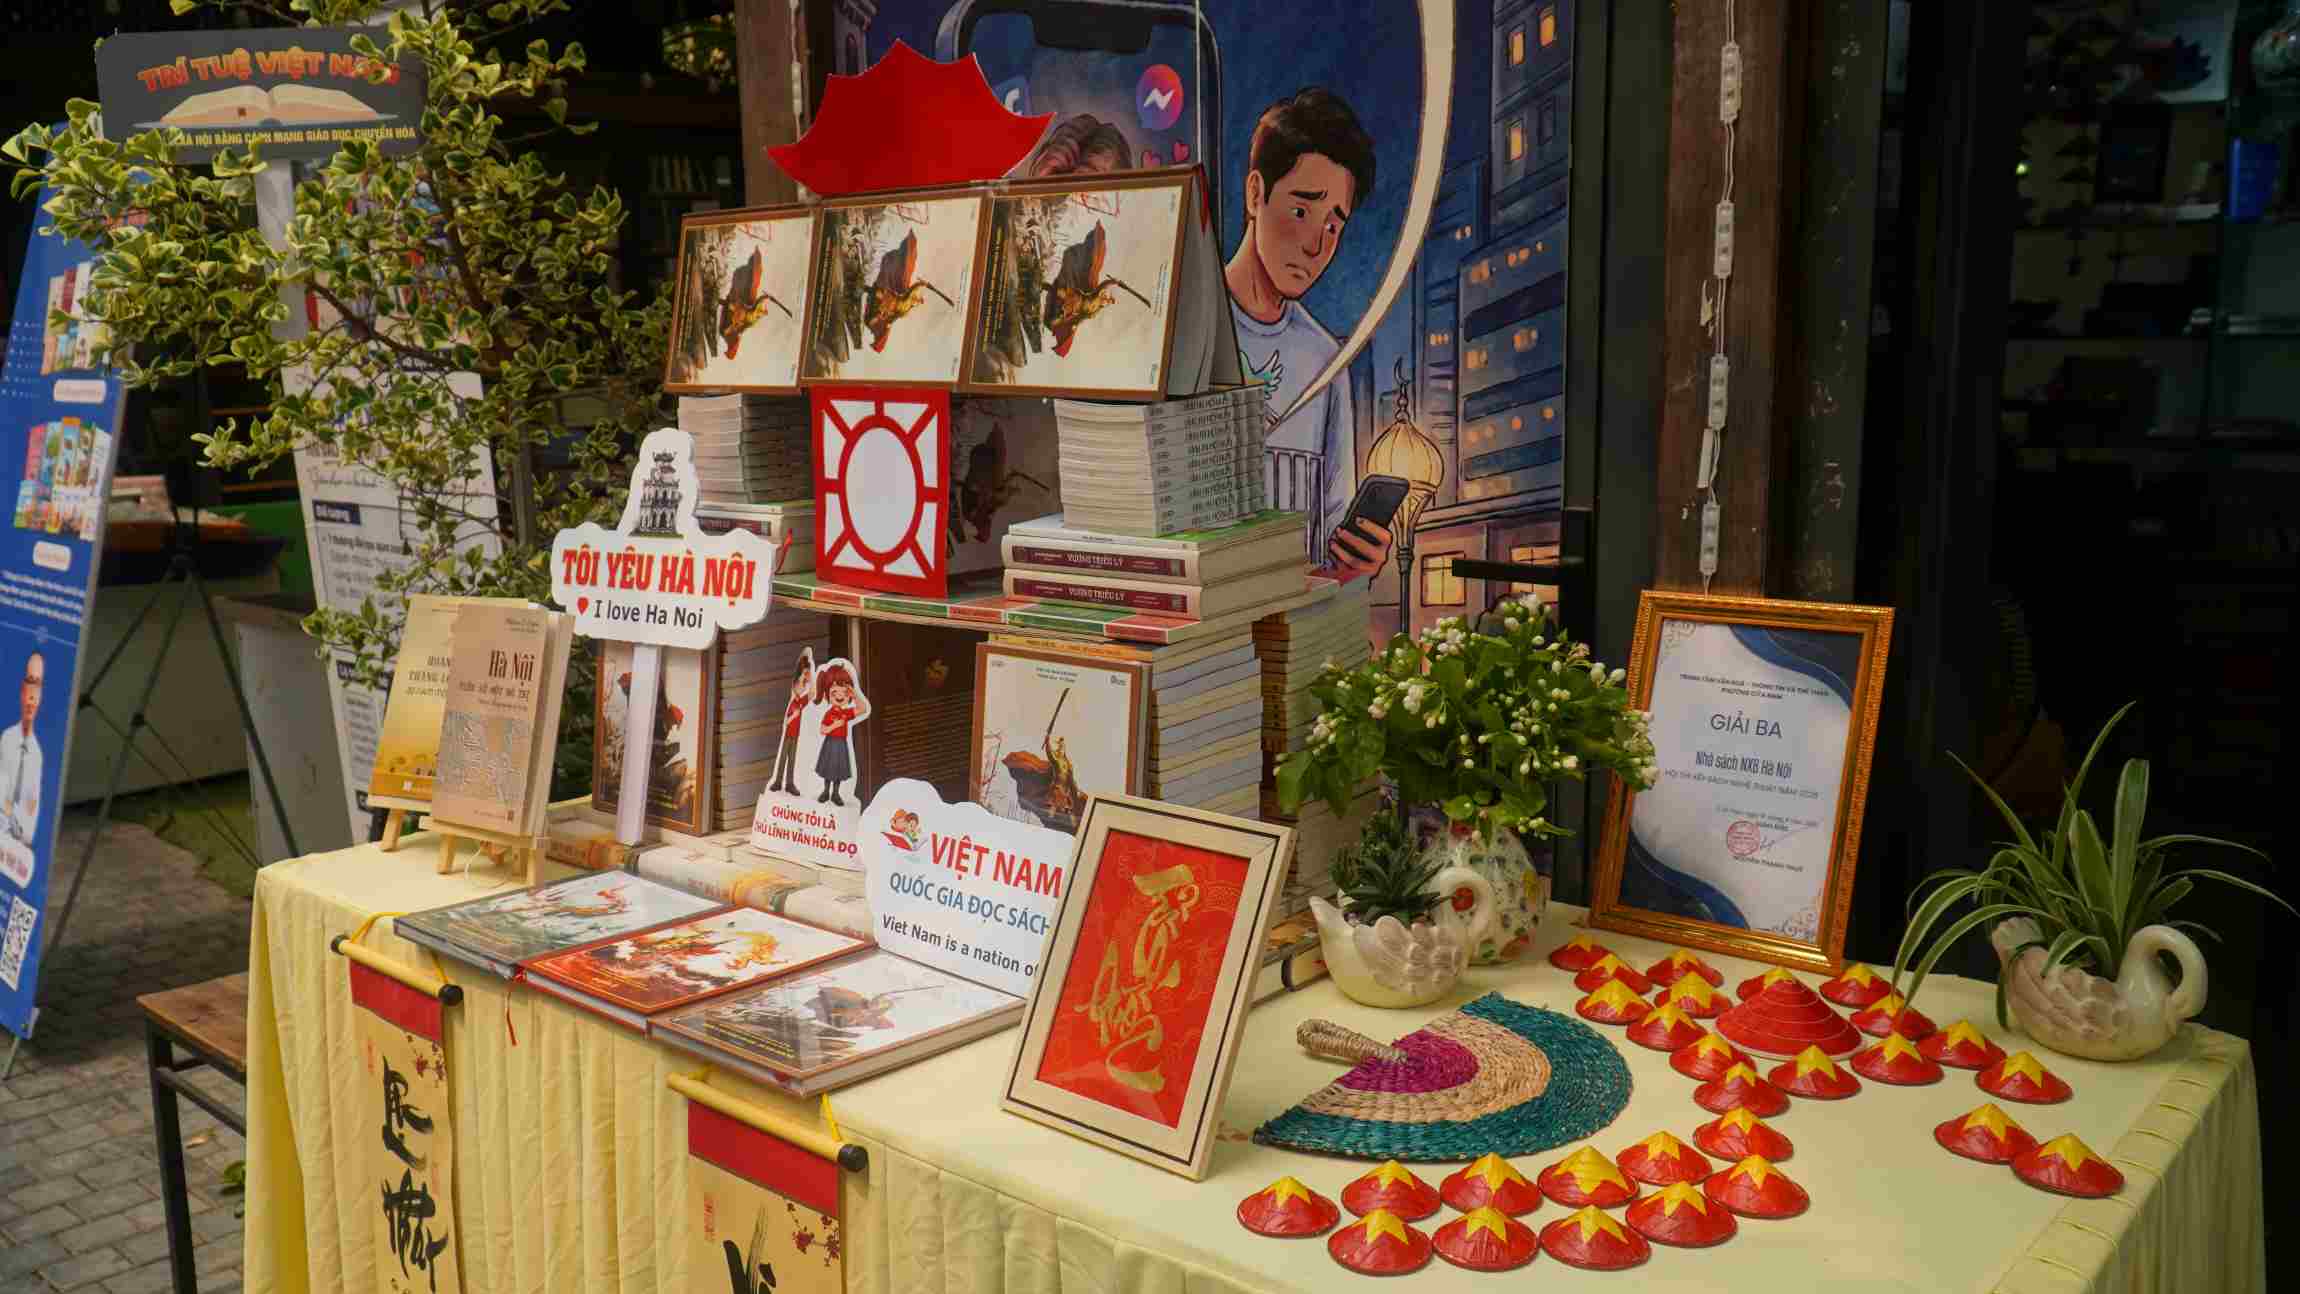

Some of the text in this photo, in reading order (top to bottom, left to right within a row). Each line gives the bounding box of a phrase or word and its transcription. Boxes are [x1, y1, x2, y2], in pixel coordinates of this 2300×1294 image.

[137, 56, 188, 92] TRÍ
[191, 48, 252, 80] TUỆ
[255, 46, 325, 79] VIỆT
[562, 544, 756, 606] TÔI YÊU HÀ NỘI
[593, 600, 703, 629] I love Ha Noi
[488, 650, 535, 687] Hà Nội
[1710, 710, 1783, 739] GIẢI BA
[1696, 751, 1793, 779] Nhà sách NXB Hà Nội
[805, 810, 820, 826] TÔI
[822, 813, 836, 831] LÀ
[835, 841, 858, 858] ĐỌ
[930, 832, 1064, 898] VIỆT NAM
[889, 872, 935, 901] QUỐC
[937, 886, 963, 911] GIA
[968, 895, 1005, 924] ĐỌC
[882, 914, 907, 936] Viet
[911, 924, 941, 946] Nam
[945, 935, 957, 952] is
[960, 943, 970, 956] a
[973, 947, 1020, 973] nation
